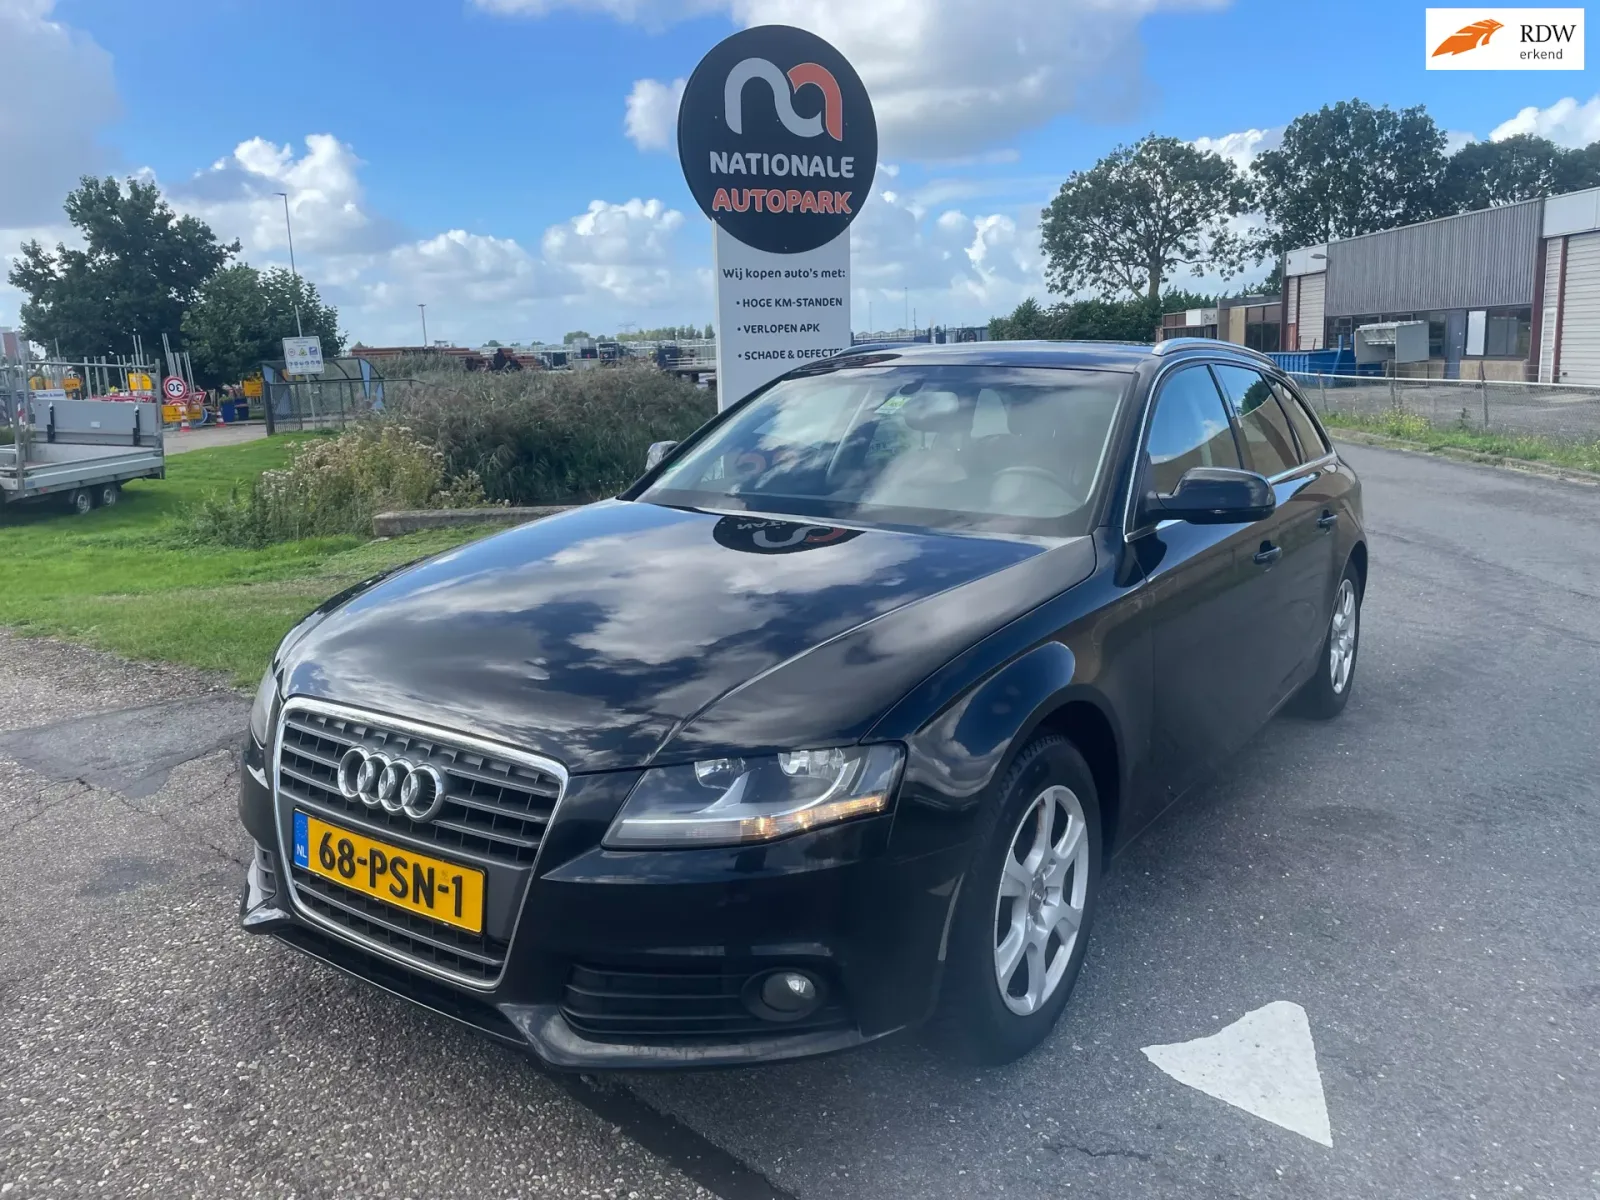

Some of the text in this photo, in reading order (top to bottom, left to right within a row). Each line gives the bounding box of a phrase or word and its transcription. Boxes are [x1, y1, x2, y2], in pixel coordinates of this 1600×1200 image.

[709, 151, 855, 178] NATIONALE
[712, 188, 853, 214] AUTOPARK
[723, 268, 846, 280] Wij kopen auto's met:
[743, 298, 842, 307] HOGE KM-STANDEN
[743, 323, 820, 333] VERLOPEN APK
[744, 350, 786, 360] SCHADE
[787, 350, 795, 359] &
[296, 843, 307, 858] NL
[318, 831, 464, 918] 68-PSN-1
